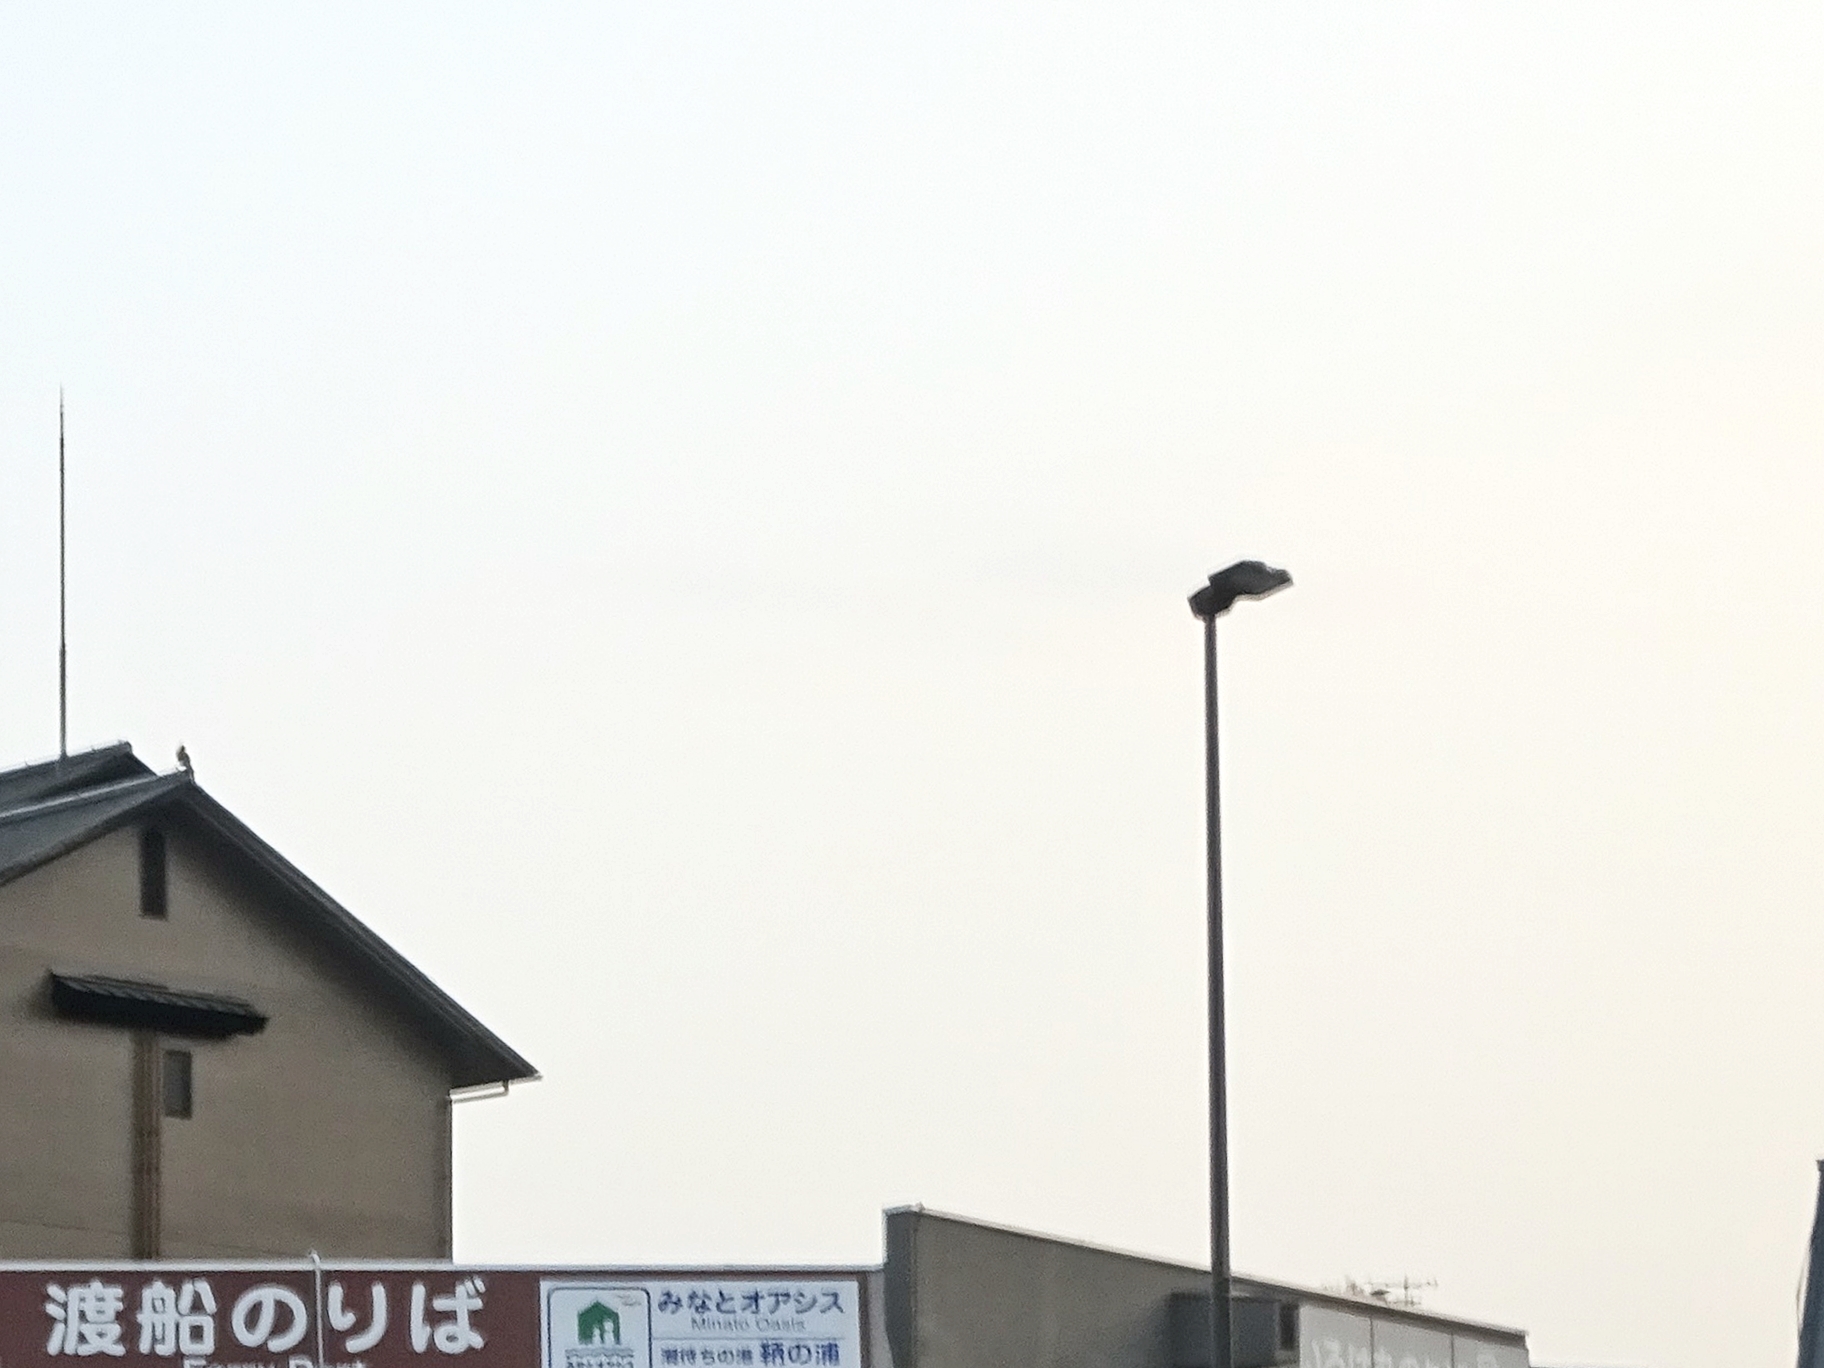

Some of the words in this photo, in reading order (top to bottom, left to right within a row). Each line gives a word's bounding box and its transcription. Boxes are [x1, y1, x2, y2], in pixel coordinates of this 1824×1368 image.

[45, 1278, 486, 1356] 渡船のりば
[658, 1290, 845, 1314] みなとオアシス
